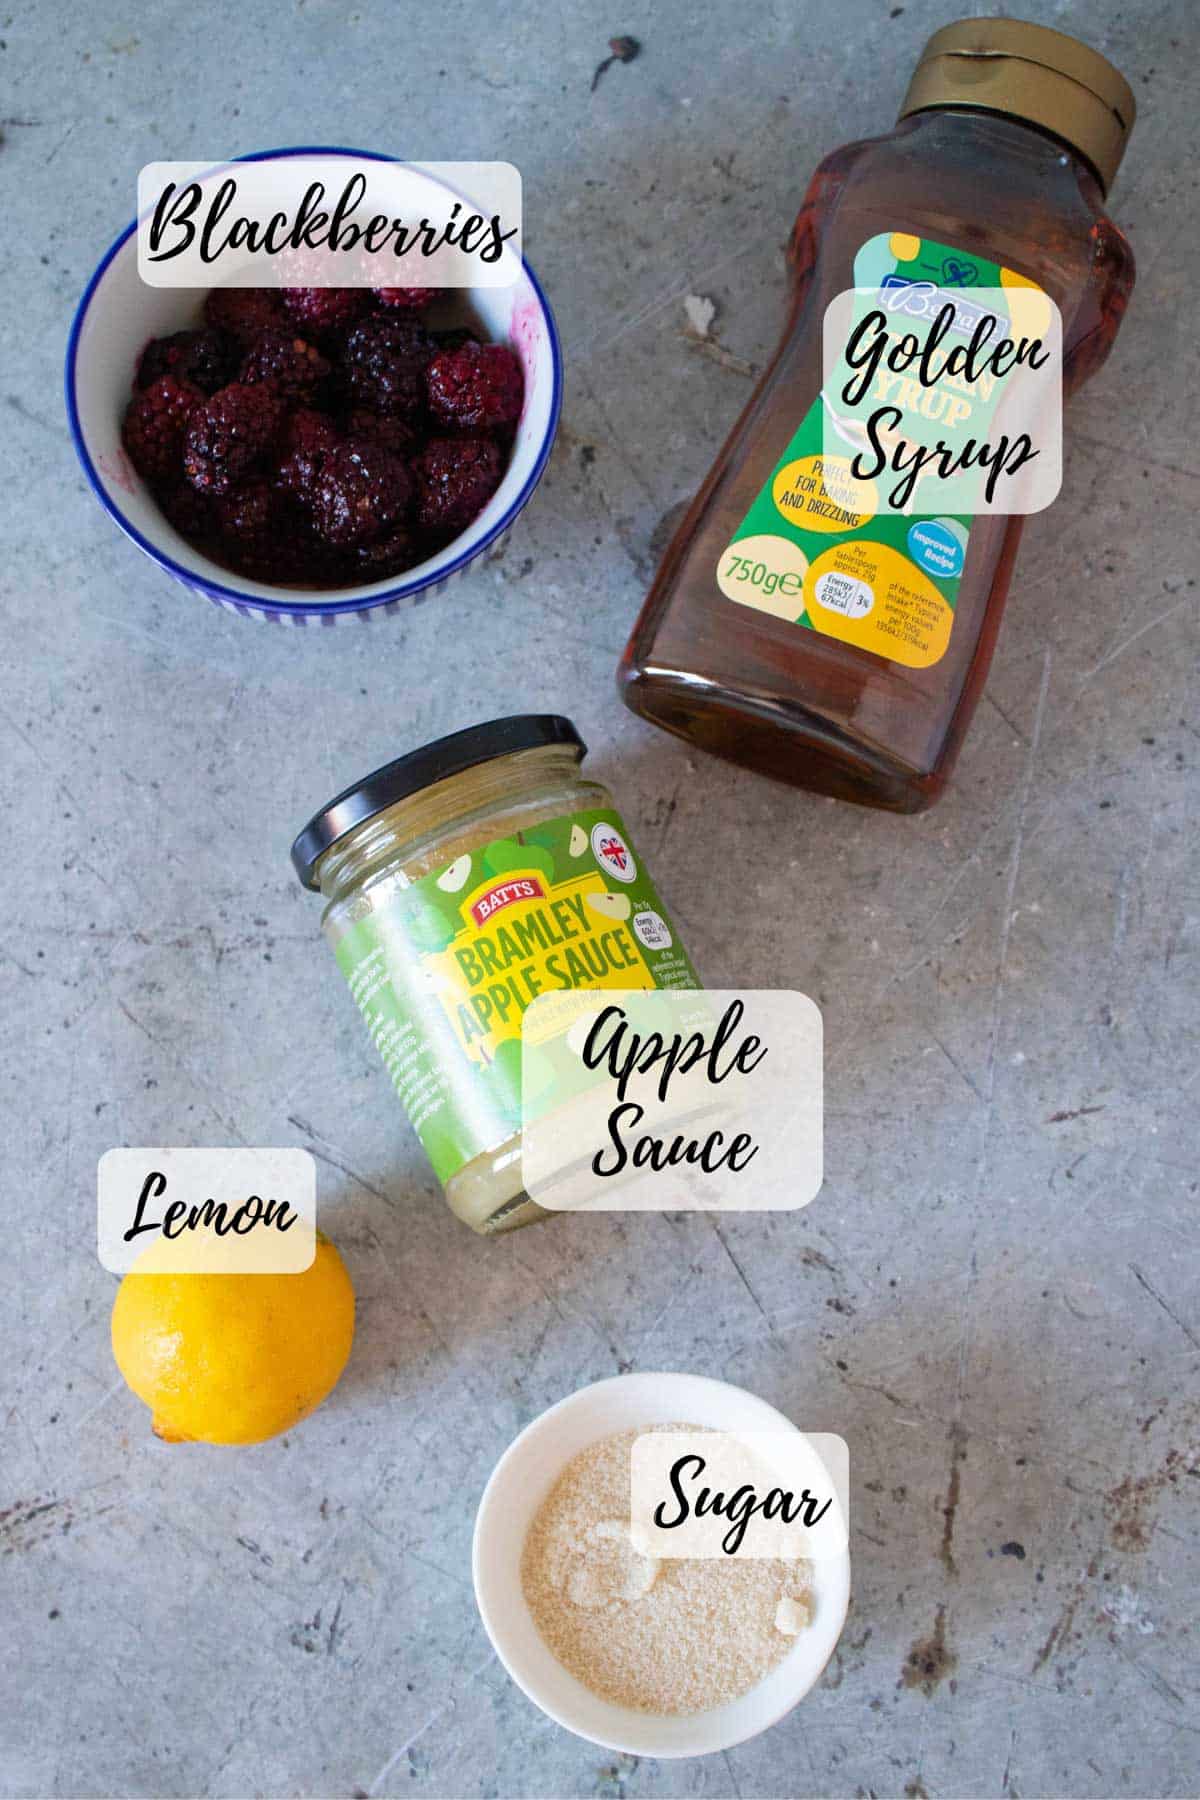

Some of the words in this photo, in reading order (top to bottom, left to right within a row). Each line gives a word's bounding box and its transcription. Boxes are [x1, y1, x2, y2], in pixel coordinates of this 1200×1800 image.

[795, 475, 817, 492] FOR
[779, 490, 804, 509] AND
[806, 499, 861, 527] DRIZZLING
[913, 530, 956, 557] Improved
[924, 548, 955, 570] Recipe
[827, 574, 853, 591] Energy
[477, 881, 536, 919] BATTS
[454, 893, 592, 987] BRAMLEY
[456, 965, 543, 1043] APPLE
[545, 927, 639, 989] SAUCE
